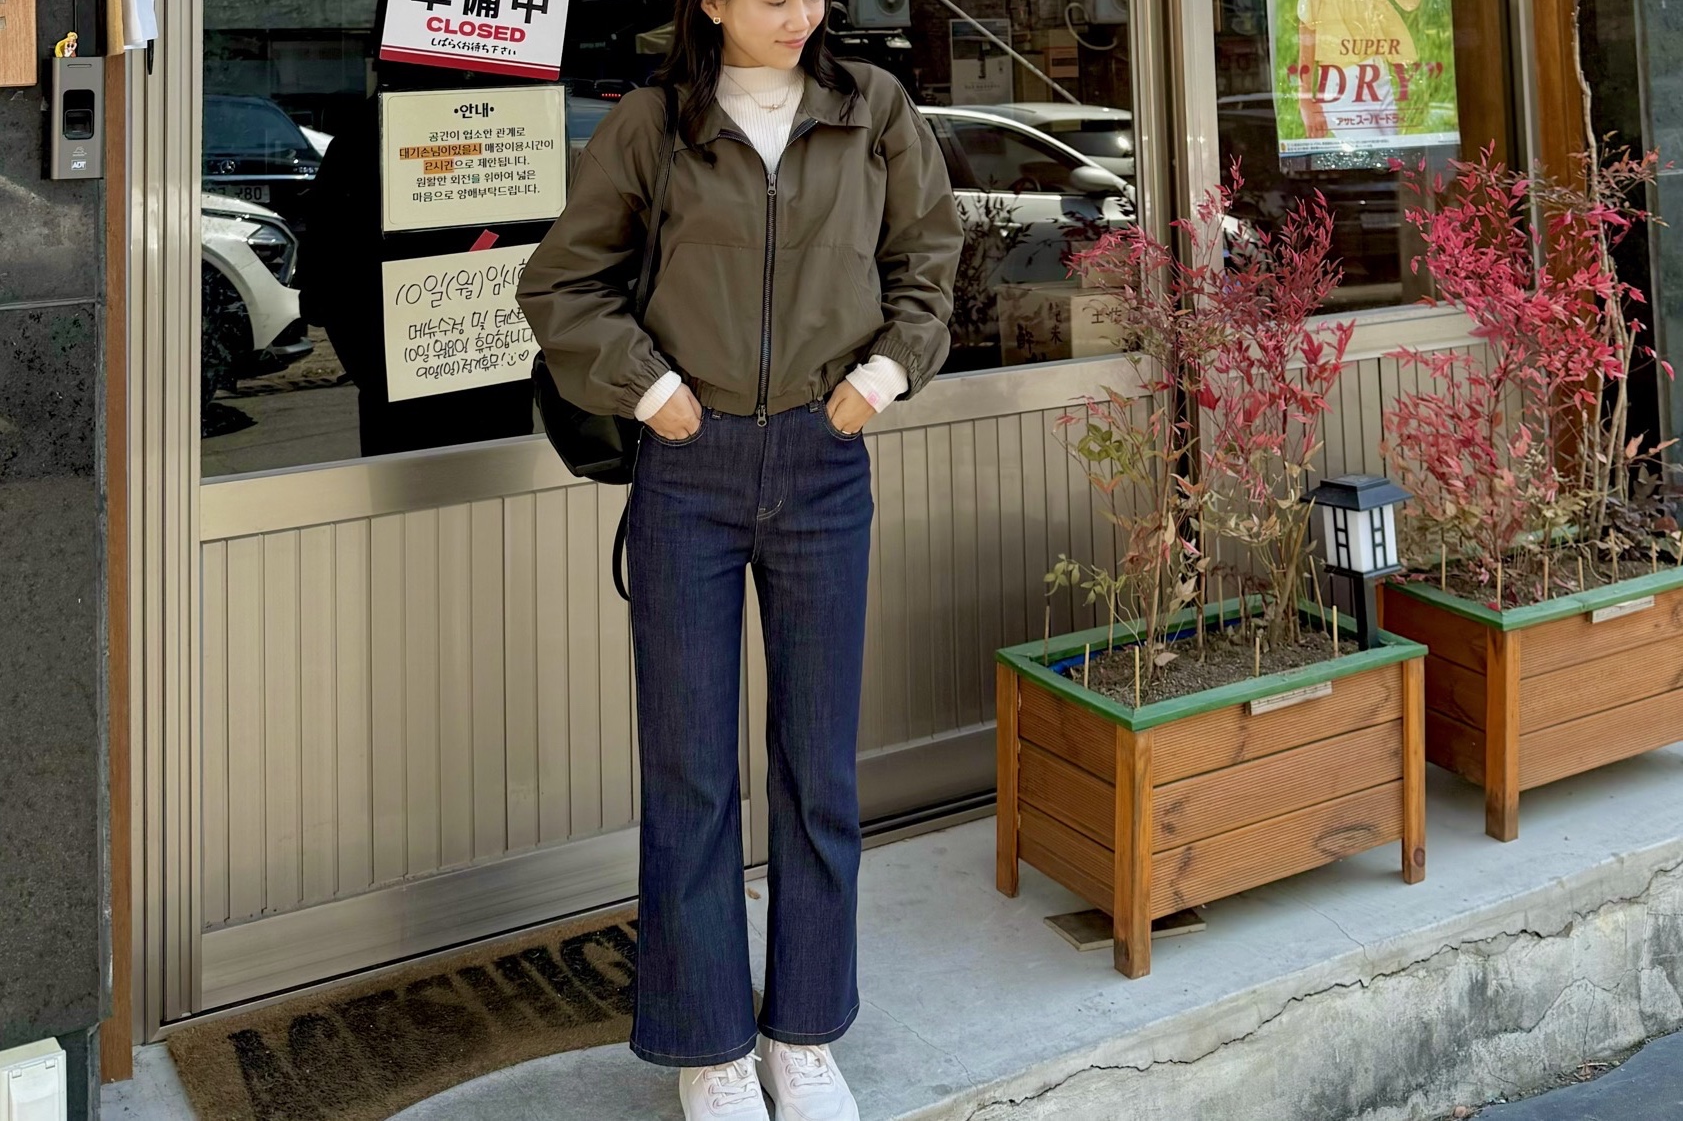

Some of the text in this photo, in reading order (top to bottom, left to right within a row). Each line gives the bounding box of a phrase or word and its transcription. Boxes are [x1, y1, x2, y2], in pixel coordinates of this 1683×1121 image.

[426, 16, 526, 43] CLOSED
[431, 37, 517, 56] しばらくお待ち下さい
[1340, 38, 1401, 56] SUPER
[495, 127, 526, 139] 관계로
[412, 190, 454, 203] 마음으로
[471, 310, 489, 330] 및
